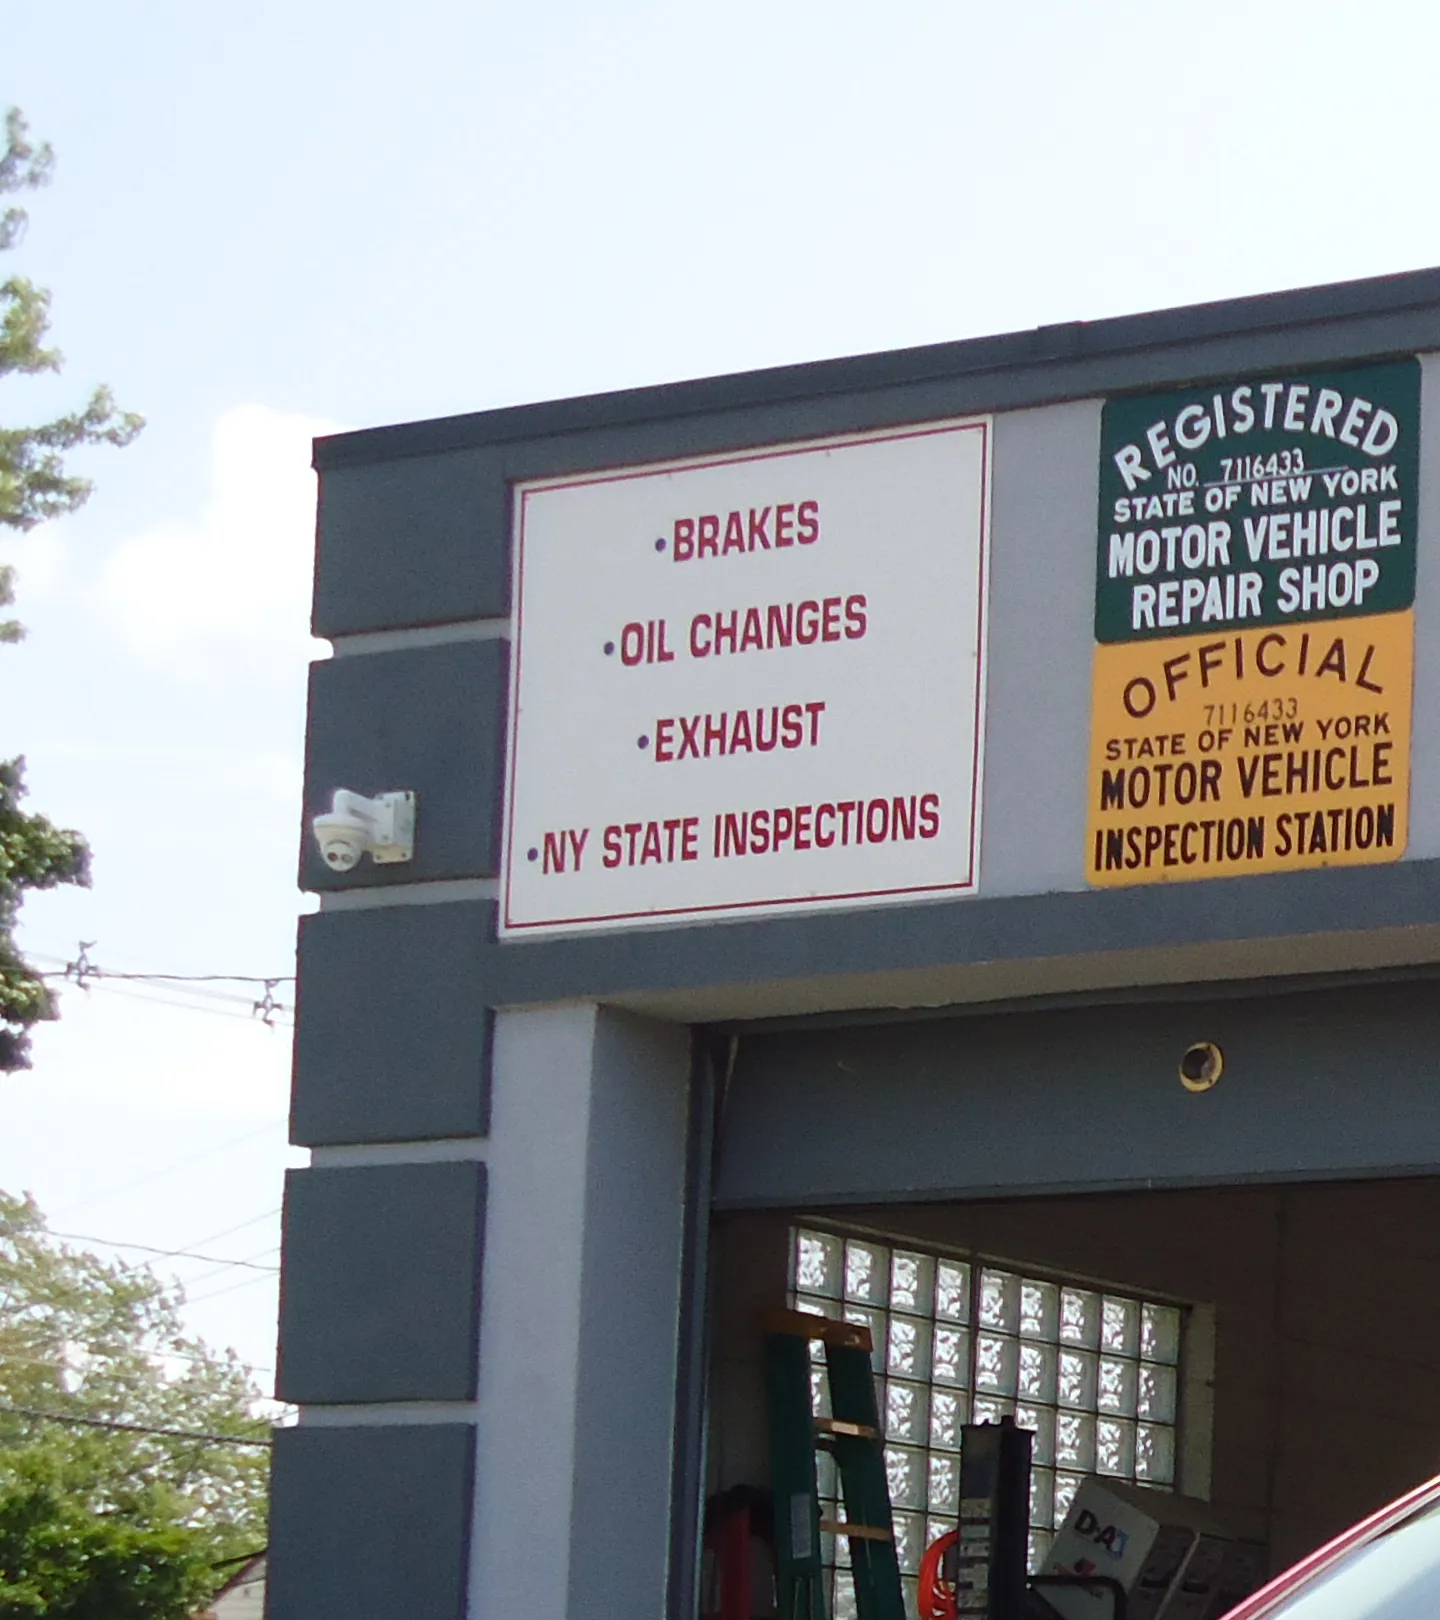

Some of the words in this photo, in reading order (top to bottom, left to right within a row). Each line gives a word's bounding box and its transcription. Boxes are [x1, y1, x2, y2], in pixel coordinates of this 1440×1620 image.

[1113, 382, 1399, 491] REGISTERED
[1167, 465, 1200, 489] NO.
[1219, 448, 1305, 484] 7116433
[1114, 490, 1195, 523] STATE
[1205, 484, 1240, 512] OF
[1250, 479, 1313, 506] NEW
[1323, 465, 1399, 494] YORK
[672, 499, 821, 563] BRAKES
[1108, 520, 1232, 579] MOTOR
[1243, 499, 1402, 564] VEHICLE
[1132, 570, 1264, 631] REPAIR
[1277, 559, 1379, 614] SHOP
[620, 619, 675, 667] OIL
[689, 594, 868, 658] CHANGES
[1123, 633, 1384, 719] OFFICIAL
[654, 702, 826, 762] EXHAUST
[1105, 732, 1187, 761] STATE
[1198, 728, 1233, 753] OF
[1243, 721, 1304, 747] NEW
[1316, 712, 1391, 741] YORK
[1203, 697, 1299, 727] 7116433
[1100, 759, 1222, 811] MOTOR
[1237, 742, 1393, 800] VEHICLE
[541, 828, 590, 875] NY
[602, 817, 699, 869] STATE
[713, 793, 940, 859] INSPECTIONS
[1094, 815, 1265, 872] INSPECTION
[1275, 803, 1395, 857] STATION
